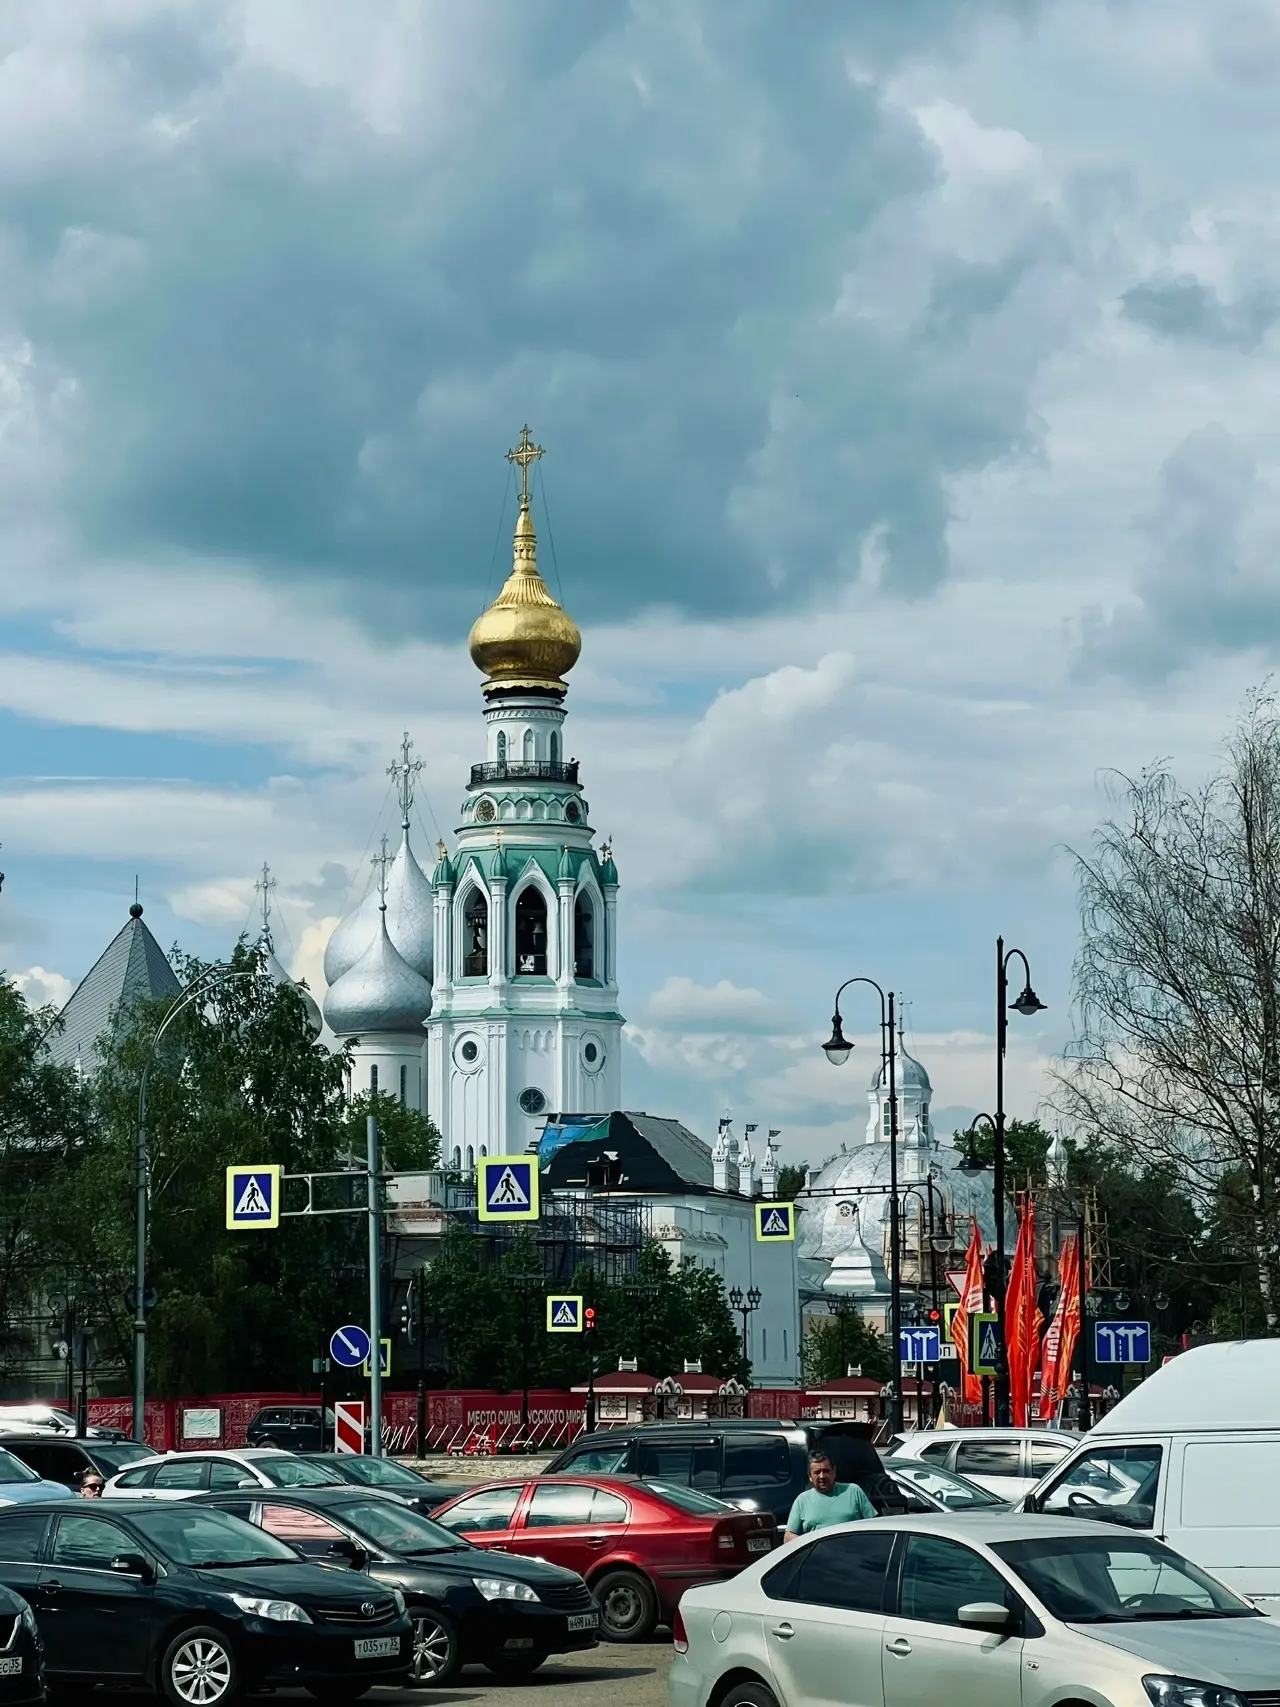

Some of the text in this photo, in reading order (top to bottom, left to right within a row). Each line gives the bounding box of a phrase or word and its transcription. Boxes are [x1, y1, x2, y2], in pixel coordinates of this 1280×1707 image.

[467, 1410, 497, 1425] МЕСТО
[499, 1410, 520, 1424] СИЛЫ
[527, 1409, 565, 1424] УССКОГО
[390, 1638, 398, 1647] 35
[11, 1659, 19, 1669] 35
